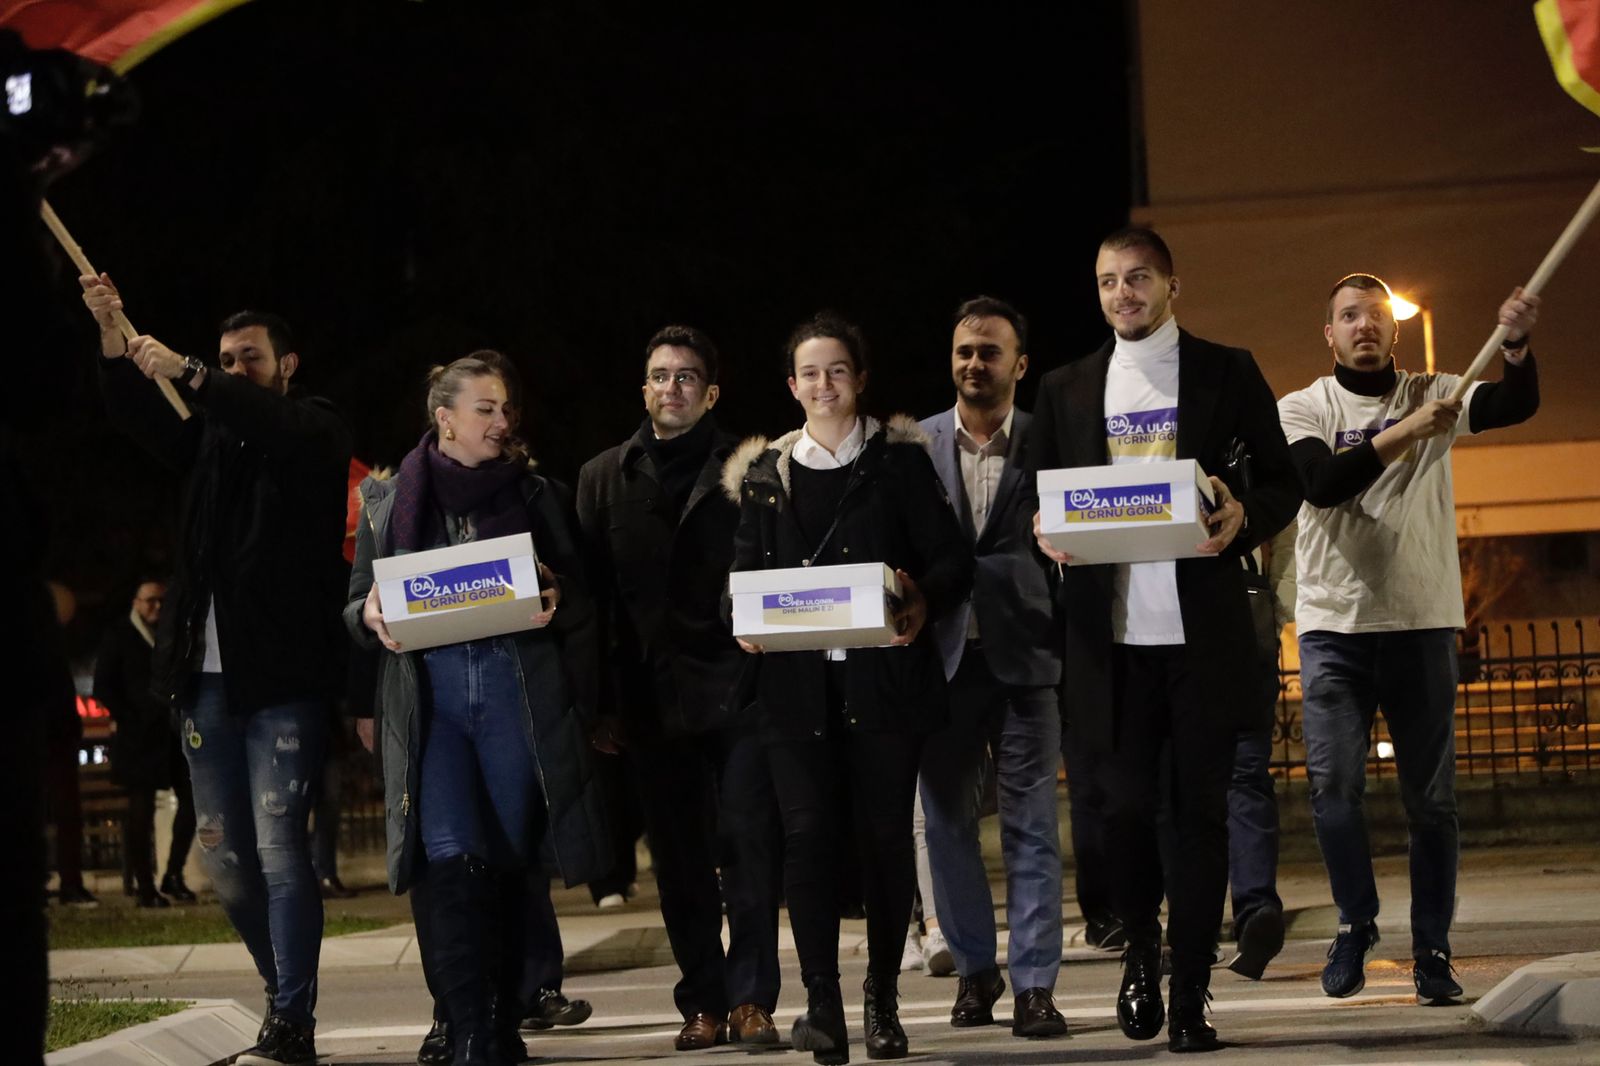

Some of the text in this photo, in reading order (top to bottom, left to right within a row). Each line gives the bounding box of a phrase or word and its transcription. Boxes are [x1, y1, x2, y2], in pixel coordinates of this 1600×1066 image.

[1110, 420, 1126, 429] DA
[1127, 424, 1144, 434] ZA
[1118, 432, 1177, 446] I CRNU GO
[1347, 432, 1361, 441] DA
[1074, 492, 1163, 509] DA ZA ULCINJ
[1081, 506, 1163, 520] I CRNU GORU
[413, 575, 504, 597] DA ZA ULCINJ
[423, 587, 506, 609] I CRNU GORU
